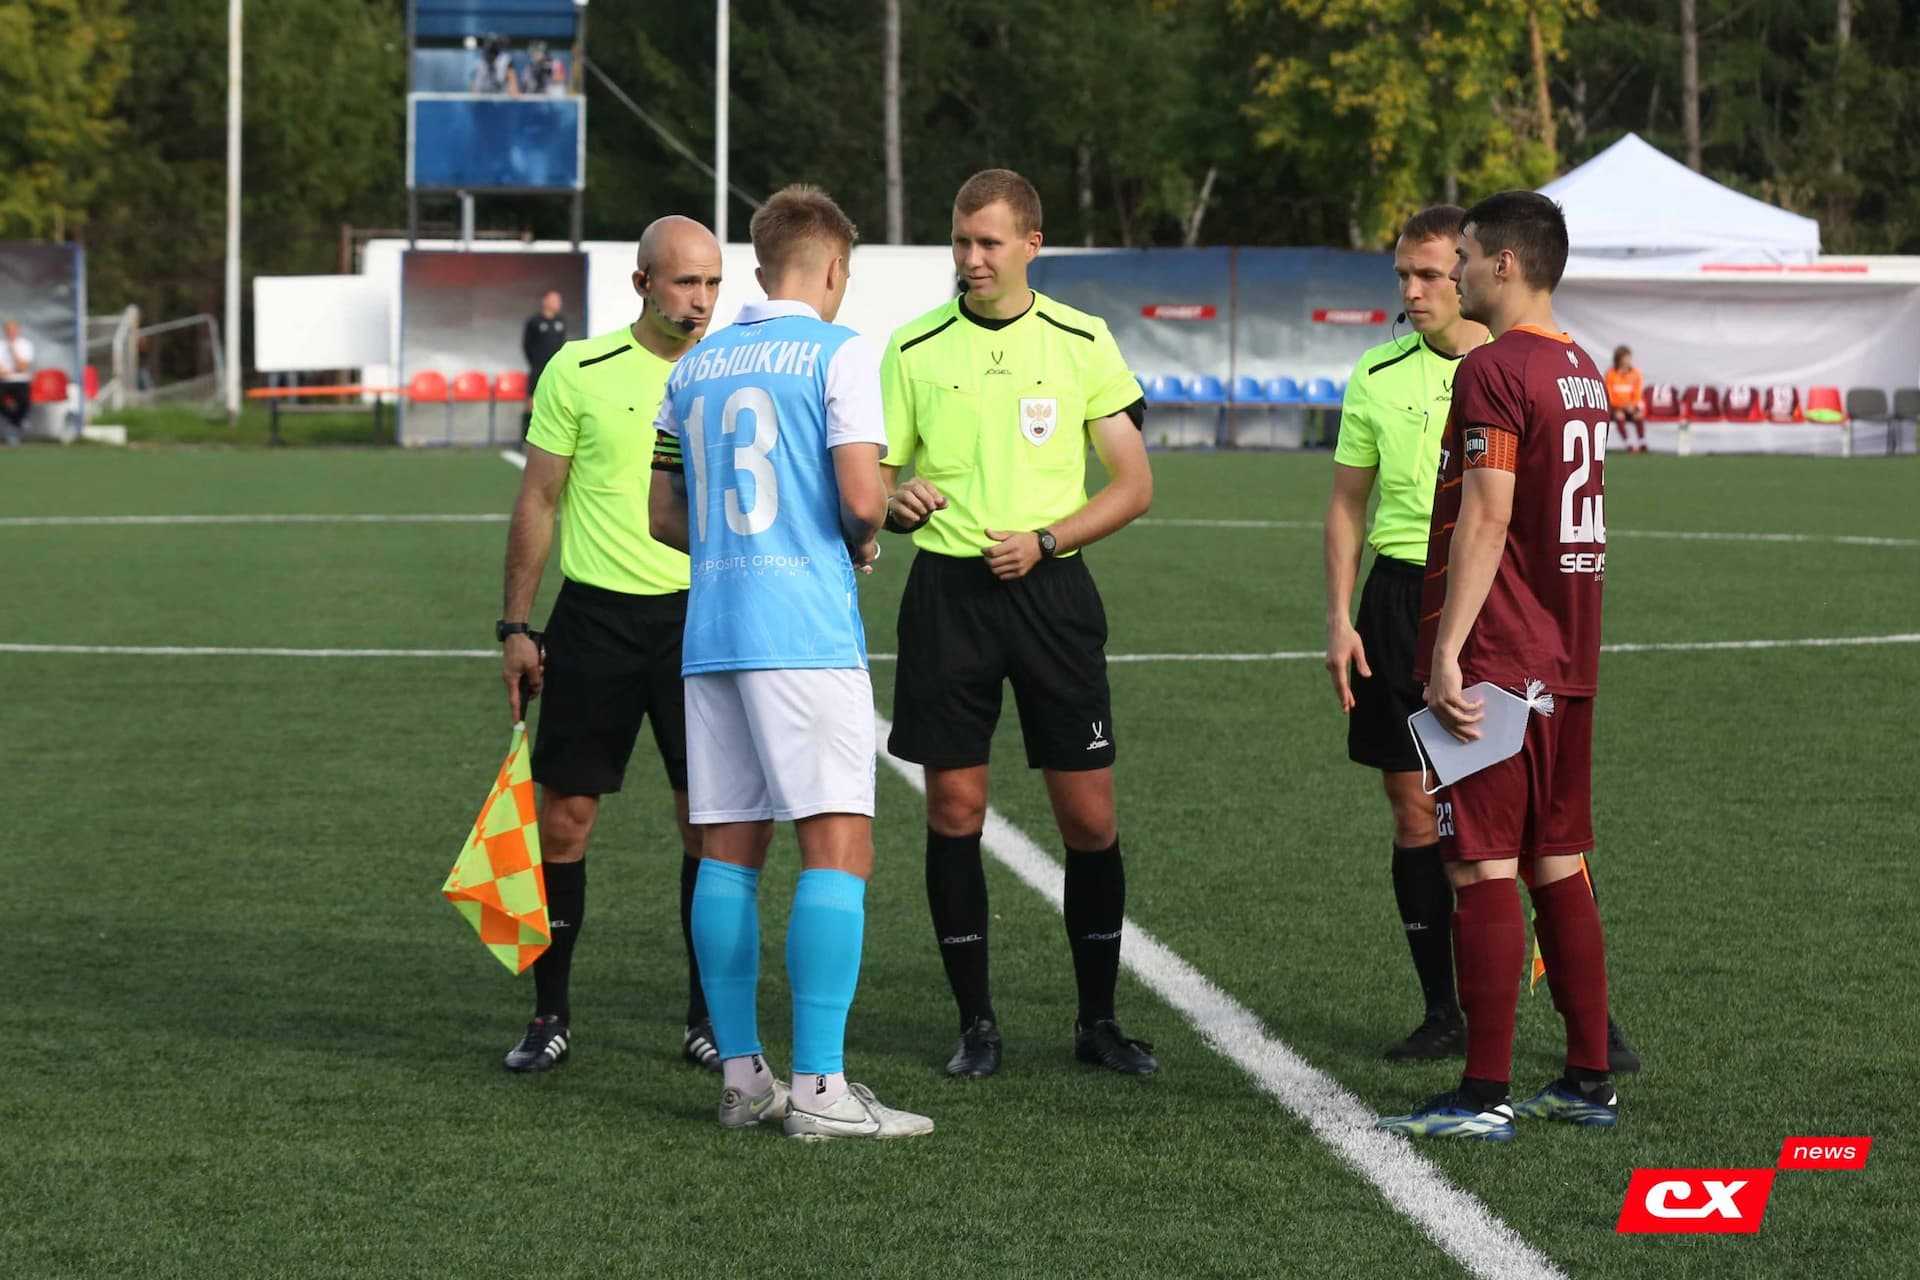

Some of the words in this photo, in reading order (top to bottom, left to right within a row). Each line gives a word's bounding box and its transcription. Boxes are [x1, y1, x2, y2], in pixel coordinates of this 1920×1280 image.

[672, 341, 821, 392] КУБЫШКИН
[684, 387, 778, 543] 13
[752, 554, 811, 569] GROUP
[1436, 802, 1454, 837] 23
